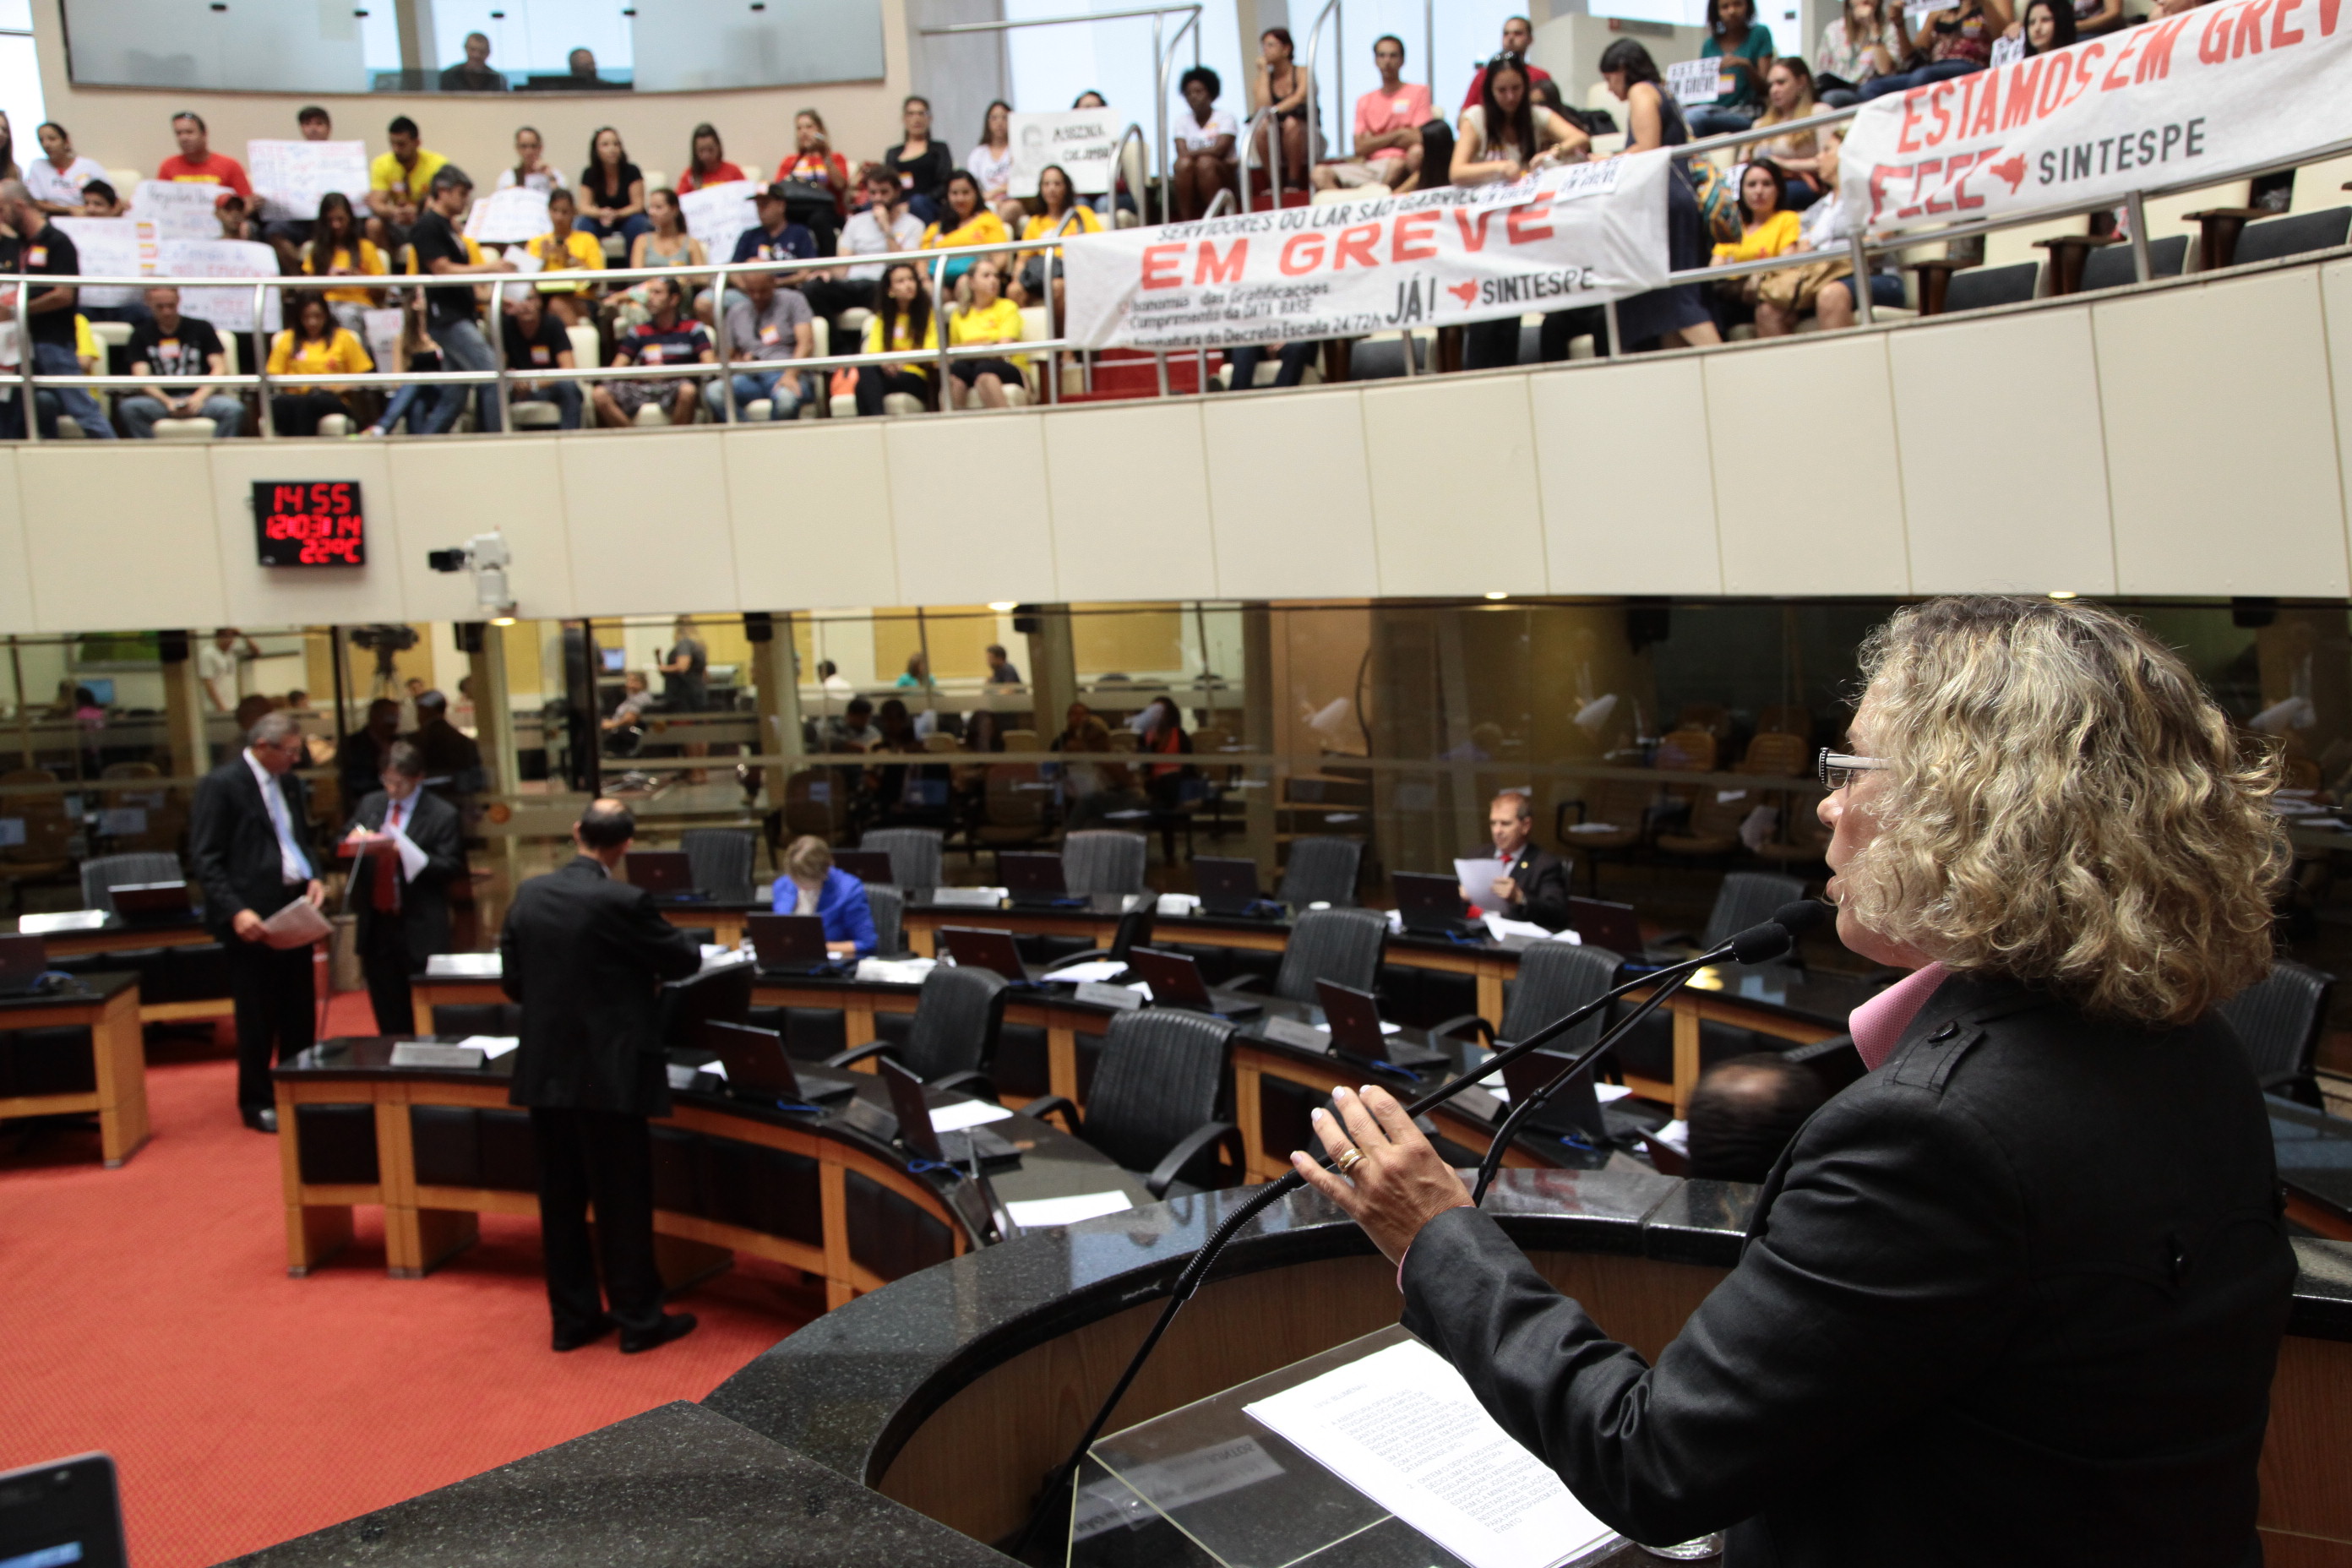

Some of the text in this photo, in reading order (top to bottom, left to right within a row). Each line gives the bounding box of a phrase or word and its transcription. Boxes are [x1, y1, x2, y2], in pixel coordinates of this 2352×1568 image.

[1897, 41, 2104, 154] ESTAMOS
[2101, 14, 2194, 93] EM
[2038, 117, 2206, 185] SINTESPE
[1141, 190, 1556, 291] EM GREVE
[1279, 210, 1307, 230] DO
[1312, 205, 1350, 227] LAR
[1386, 267, 1595, 324] JÁ! SINTESPE
